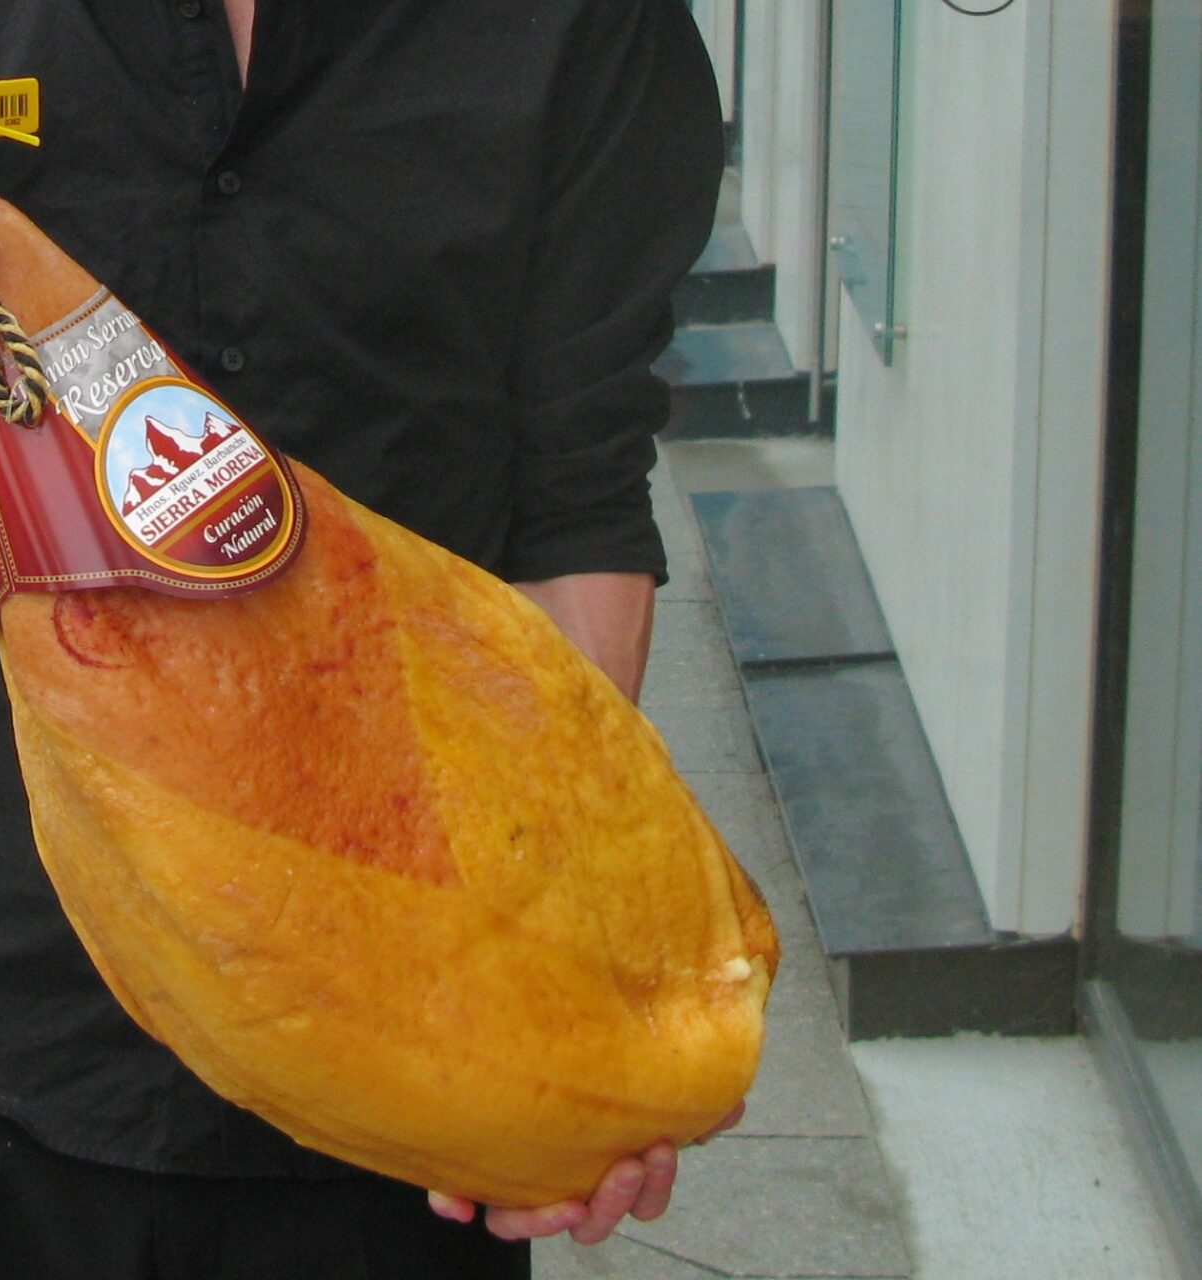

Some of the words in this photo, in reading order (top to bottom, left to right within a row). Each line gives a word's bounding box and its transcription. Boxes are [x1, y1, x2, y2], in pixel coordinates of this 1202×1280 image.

[55, 339, 167, 425] Reserva
[135, 495, 171, 523] Hnos.
[139, 487, 208, 543] SIERRA
[204, 443, 264, 494] MORENA
[203, 493, 265, 544] Curación
[220, 508, 278, 561] Natural
